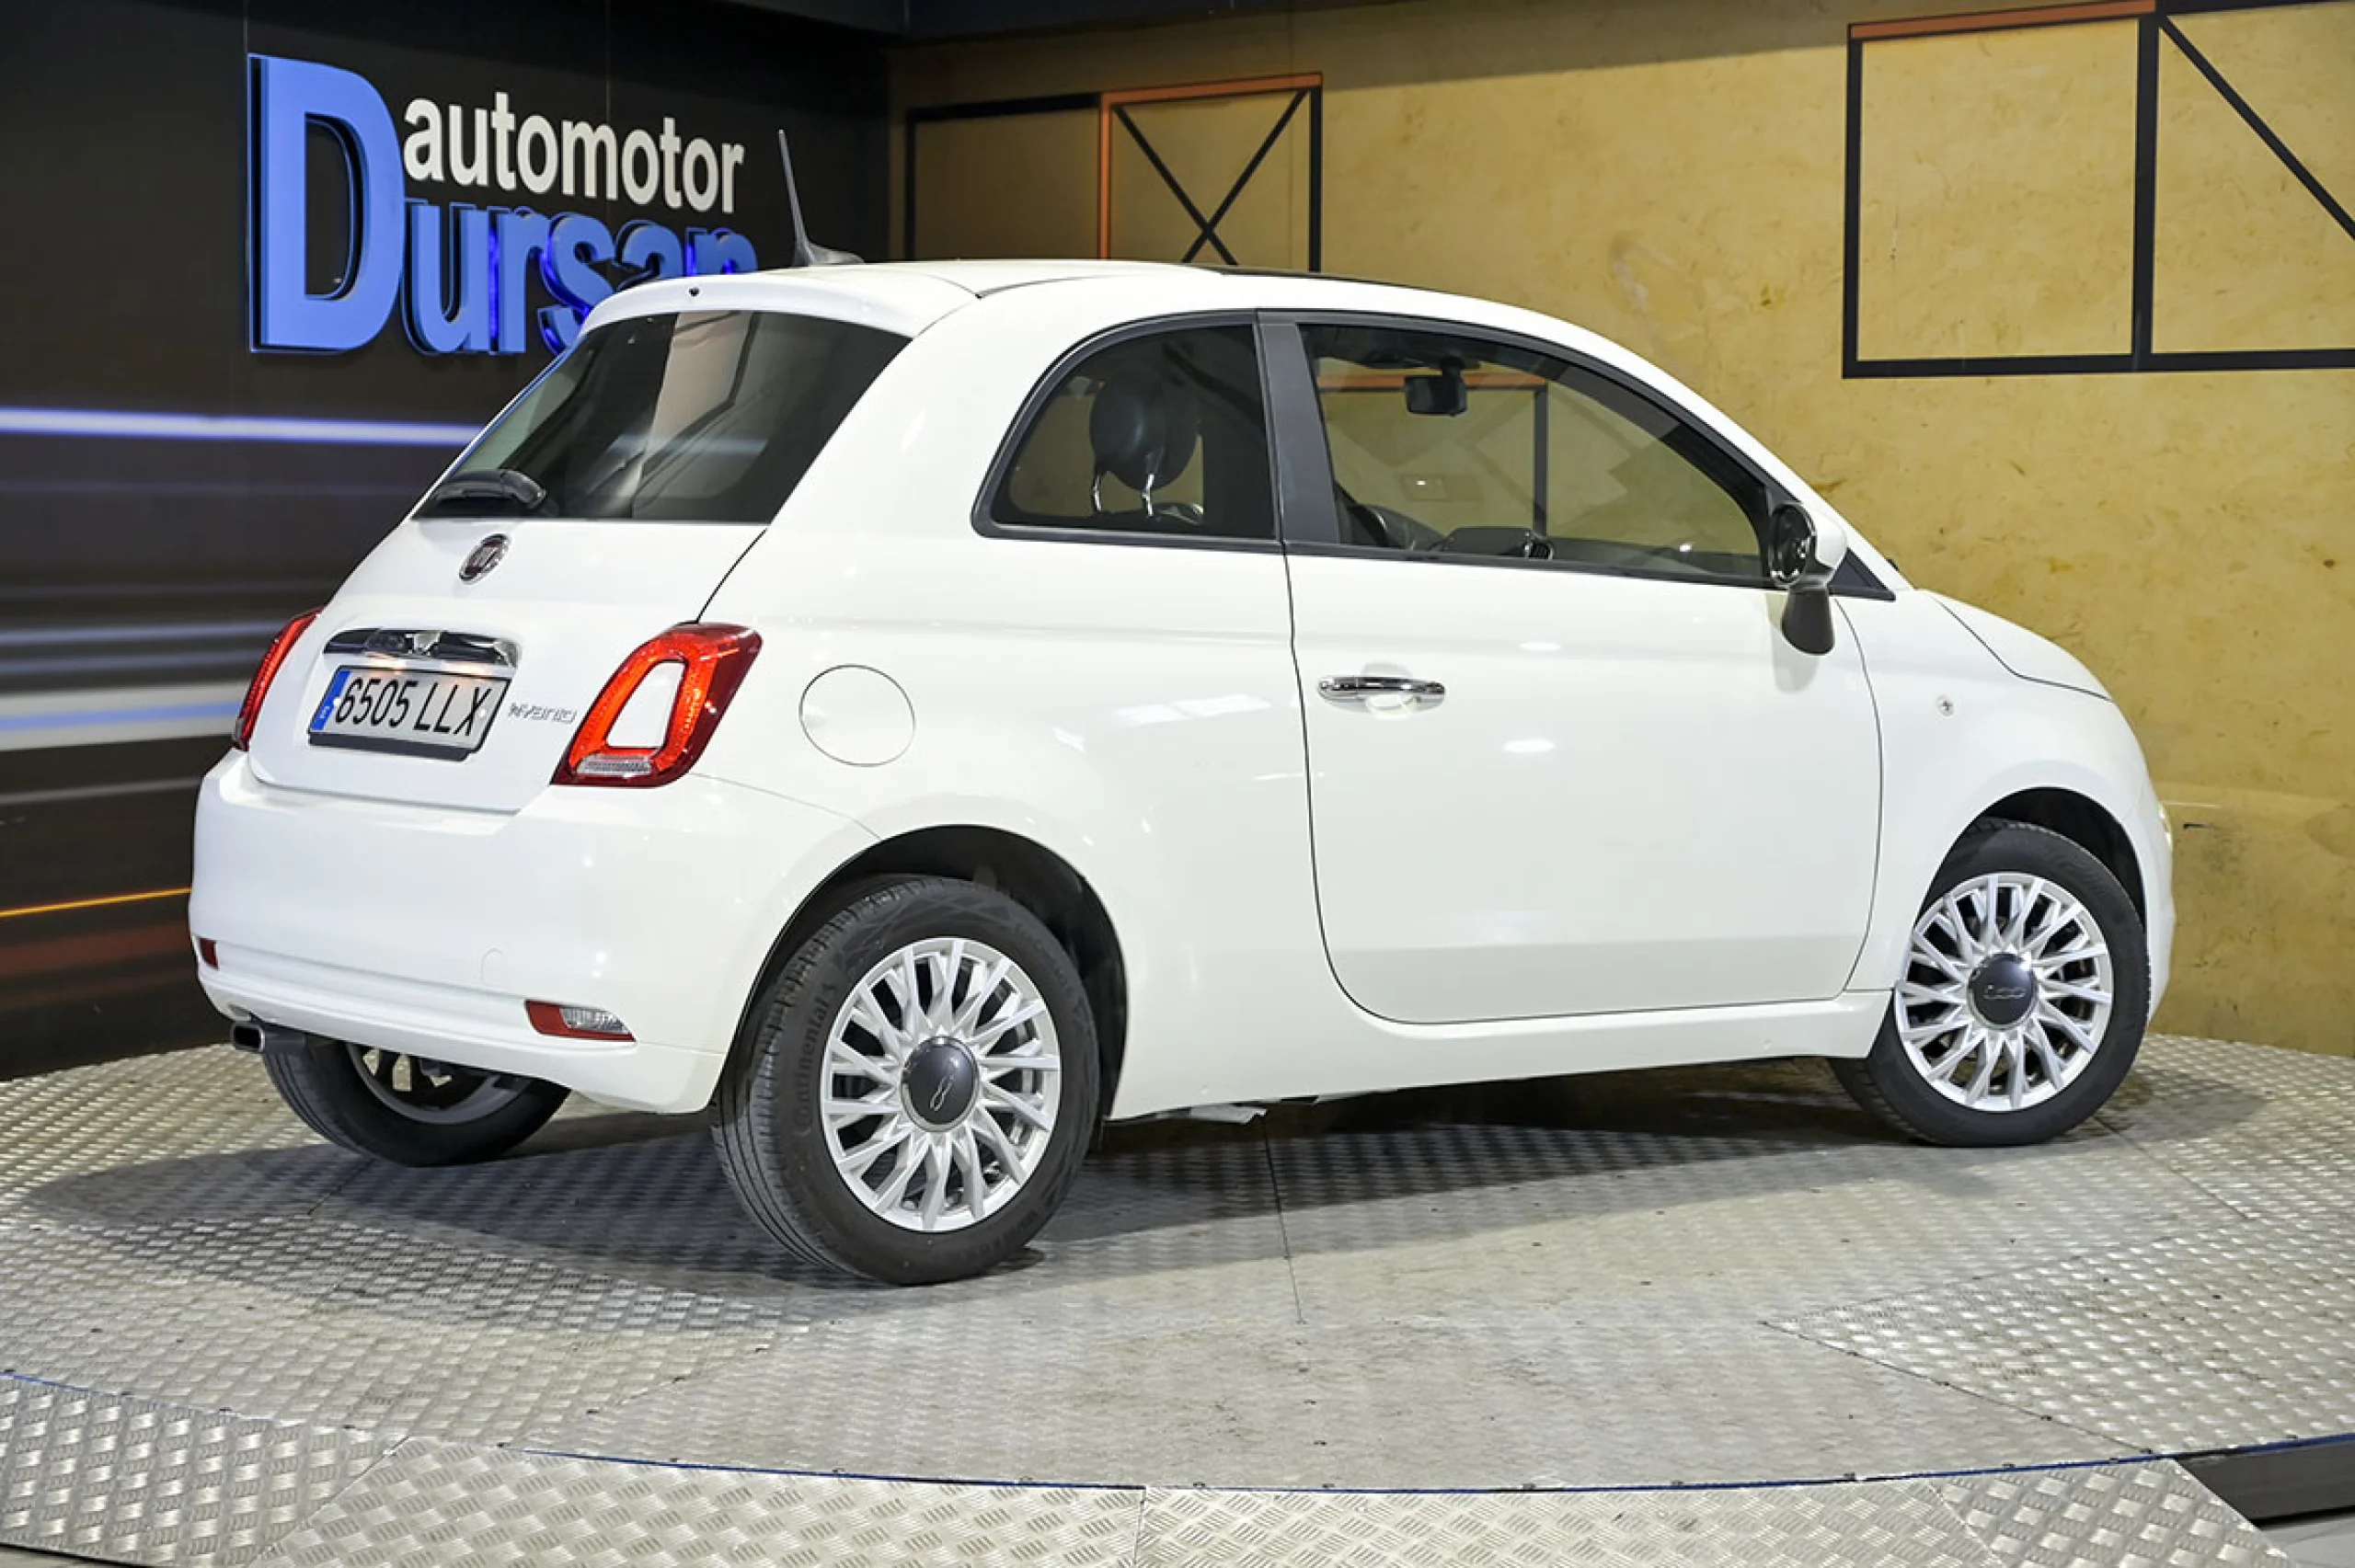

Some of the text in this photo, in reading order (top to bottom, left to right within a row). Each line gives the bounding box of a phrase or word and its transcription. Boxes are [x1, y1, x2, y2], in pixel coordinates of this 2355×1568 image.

[403, 92, 744, 212] automotor
[336, 677, 492, 737] 6505 LLX
[793, 995, 829, 1129] Continental
